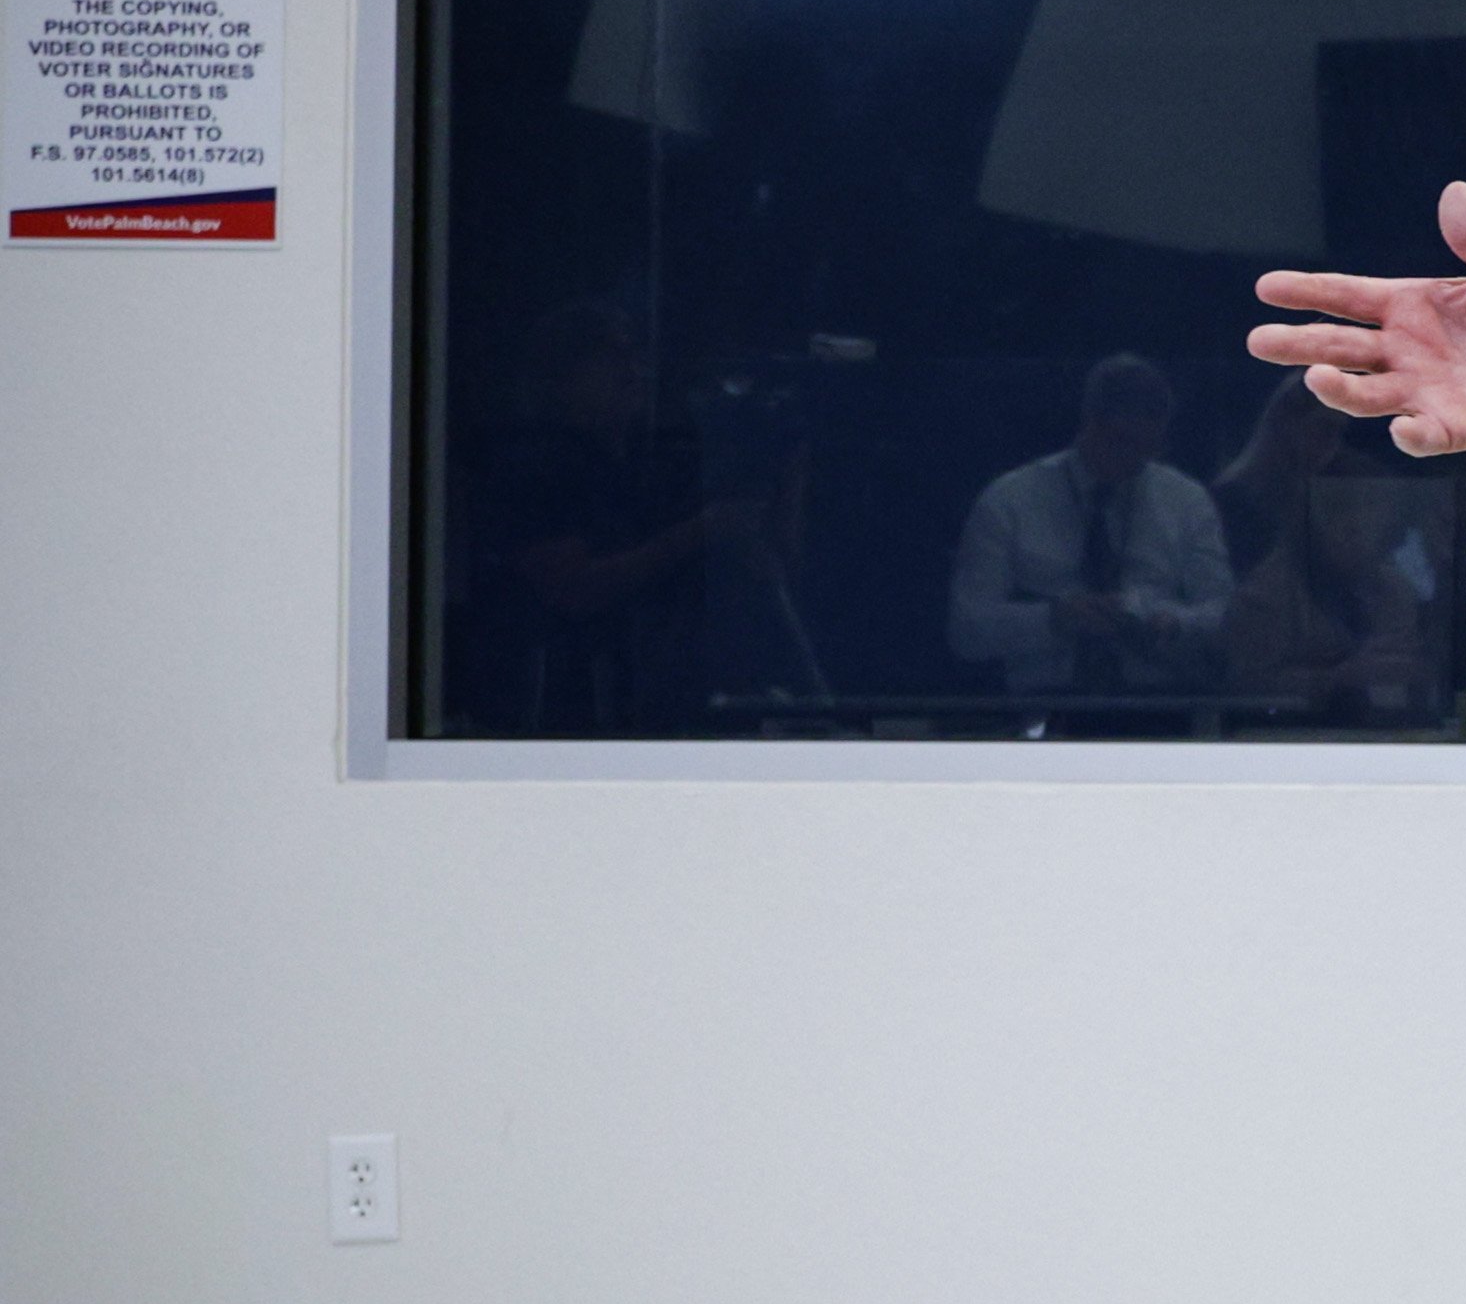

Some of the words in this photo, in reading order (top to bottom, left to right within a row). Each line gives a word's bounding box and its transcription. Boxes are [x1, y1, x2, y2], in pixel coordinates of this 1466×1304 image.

[73, 0, 114, 15] THE
[121, 0, 224, 17] COPYING,
[44, 20, 213, 38] PHOTOGRAPHY,
[220, 22, 251, 37] OR
[29, 41, 94, 57] VIDEO
[102, 41, 230, 58] RECORDING
[237, 43, 265, 58] OF
[39, 61, 111, 77] VOTER
[119, 62, 255, 79] SIGNATURES
[65, 83, 96, 98] OR
[103, 83, 201, 99] BALLOTS
[209, 85, 228, 100] IS
[81, 105, 217, 122] PROHIBITED,
[69, 125, 186, 141] PURSUANT
[195, 126, 222, 142] TO
[31, 146, 66, 161] F.S.
[65, 214, 221, 234] VotePalmBeach.gov
